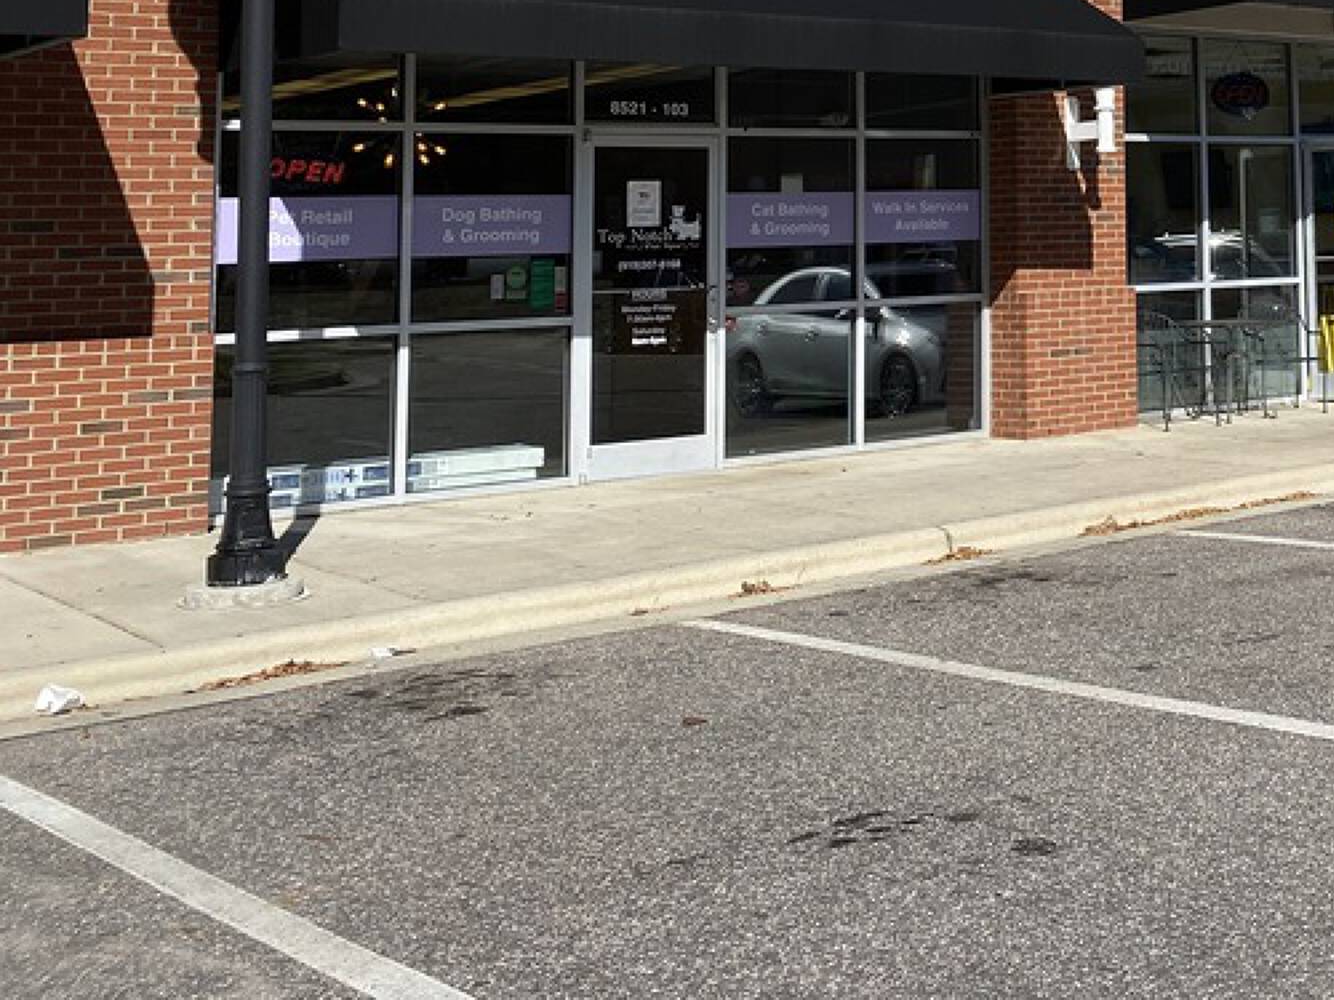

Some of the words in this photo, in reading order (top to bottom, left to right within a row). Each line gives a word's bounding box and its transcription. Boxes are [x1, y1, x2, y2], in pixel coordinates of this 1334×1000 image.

[610, 100, 647, 116] 8521
[662, 102, 689, 117] 103
[270, 157, 345, 184] OPEN
[301, 208, 353, 225] Retail
[442, 207, 476, 227] Dog
[479, 207, 543, 226] Bathing
[751, 202, 775, 217] Cat
[778, 202, 829, 219] Bathing
[750, 223, 760, 236] &
[764, 221, 830, 237] Grooming
[895, 217, 950, 231] Available
[270, 231, 351, 249] Boutique
[442, 229, 454, 243] &
[460, 228, 540, 245] Grooming
[597, 228, 625, 248] Top
[631, 227, 673, 244] Notch
